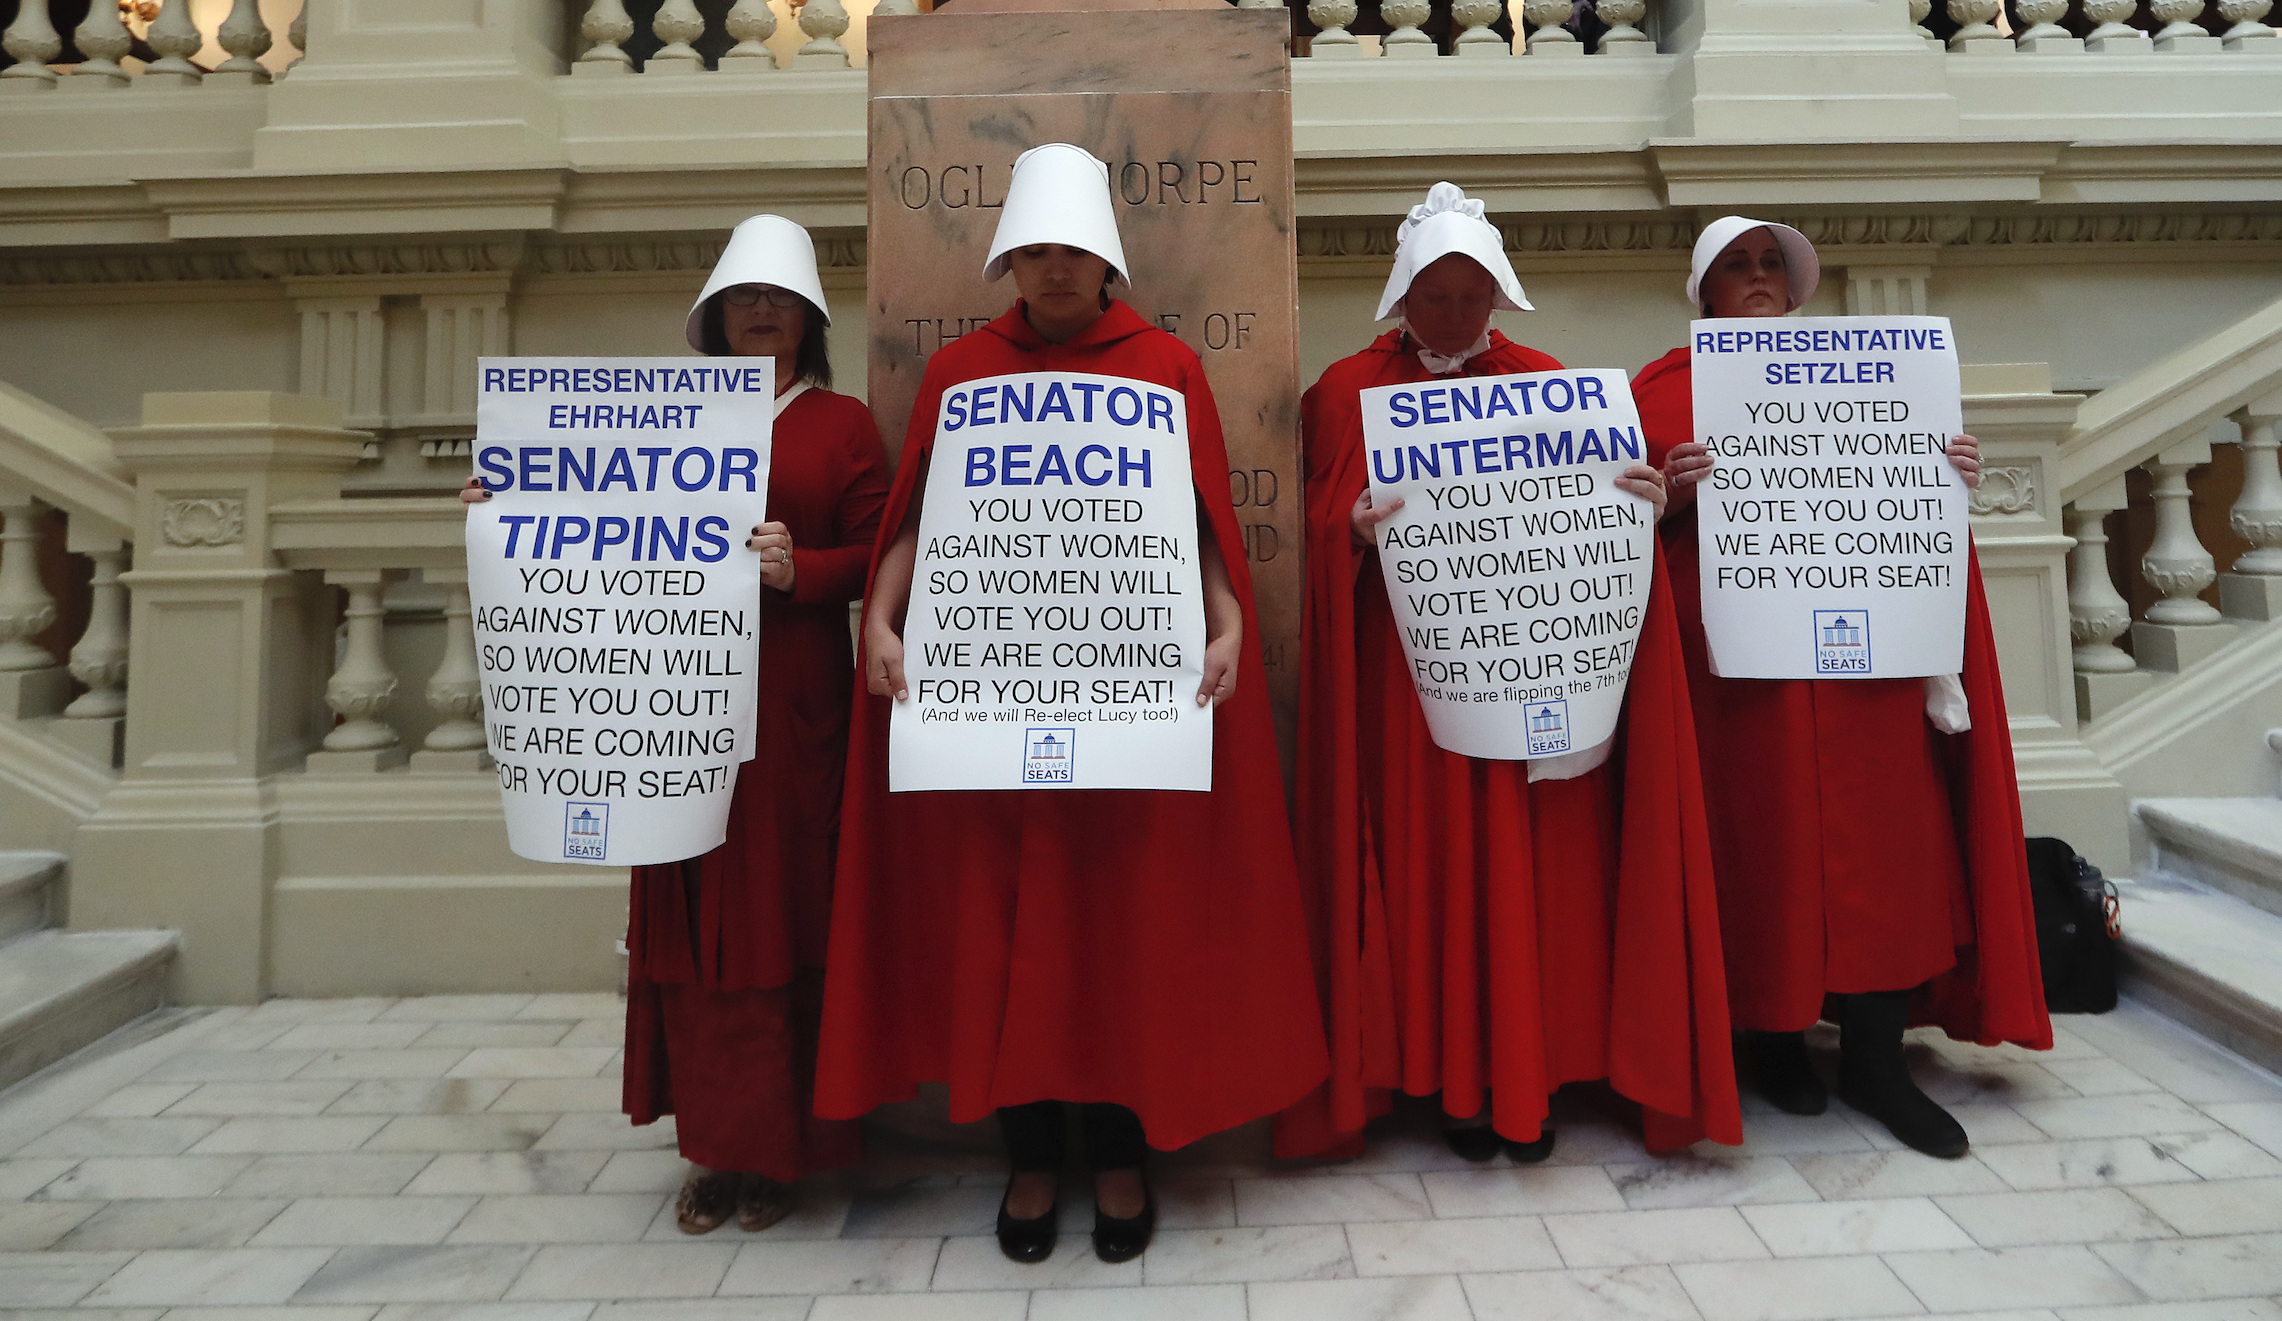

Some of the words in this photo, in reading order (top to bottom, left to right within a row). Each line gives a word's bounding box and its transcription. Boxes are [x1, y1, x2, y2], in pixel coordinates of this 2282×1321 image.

[1204, 312, 1257, 351] OF
[1697, 329, 1945, 353] REPRESENTATIVE
[485, 368, 761, 393] REPRESENTATIVE
[1766, 362, 1894, 384] SETZLER
[944, 382, 1175, 434] SENATOR
[1389, 376, 1607, 428] SENATOR
[1745, 402, 1805, 424] YOU
[1814, 401, 1909, 423] VOTED
[548, 405, 702, 430] EHRHART
[1373, 426, 1640, 484] UNTERMAN
[1704, 434, 1824, 457] AGAINST
[1834, 433, 1947, 455] WOMEN
[479, 447, 758, 492] SENATOR
[964, 444, 1152, 488] BEACH
[1712, 468, 1751, 490] SO
[1760, 467, 1873, 489] WOMEN
[1883, 466, 1950, 488] WILL
[1426, 484, 1490, 511] YOU
[1500, 474, 1594, 503] VOTED
[969, 499, 1032, 522] YOU
[1042, 499, 1143, 522] VOTED
[1722, 500, 1797, 522] VOTE
[1805, 500, 1866, 522] YOU
[1877, 499, 1943, 521] OUT!
[1385, 516, 1513, 550] AGAINST
[1522, 503, 1644, 538] WOMEN,
[498, 516, 731, 563] TIPPINS
[925, 534, 1051, 561] AGAINST
[1060, 534, 1186, 564] WOMEN,
[1715, 533, 1760, 555] WE
[1769, 533, 1825, 555] ARE
[1835, 532, 1952, 555] COMING
[1397, 559, 1437, 584] SO
[1447, 546, 1566, 580] WOMEN
[1573, 538, 1640, 565] WILL
[520, 569, 589, 595] YOU
[601, 571, 705, 596] VOTED
[928, 571, 968, 595] SO
[979, 570, 1100, 594] WOMEN
[1112, 570, 1182, 595] WILL
[1718, 567, 1776, 589] FOR
[1785, 566, 1868, 588] YOUR
[1878, 566, 1950, 588] SEAT!
[1409, 590, 1487, 617] VOTE
[1496, 581, 1559, 610] YOU
[1570, 573, 1634, 601] OUT!
[477, 606, 605, 634] AGAINST
[615, 609, 752, 639] WOMEN,
[935, 606, 1013, 631] VOTE
[1023, 606, 1089, 631] YOU
[1100, 606, 1172, 631] OUT!
[1407, 624, 1450, 651] WE
[1460, 622, 1520, 649] ARE
[1529, 606, 1638, 644] COMING
[483, 647, 516, 673] SO
[525, 647, 651, 675] WOMEN
[663, 649, 742, 676] WILL
[924, 643, 971, 667] WE
[981, 643, 1043, 667] ARE
[1053, 643, 1181, 668] COMING
[1415, 659, 1469, 683] FOR
[1477, 654, 1563, 683] YOUR
[1574, 639, 1635, 674] SEAT!
[1821, 658, 1866, 670] SEATS
[490, 685, 556, 714] VOTE
[568, 687, 638, 716] YOU
[649, 688, 729, 717] OUT!
[919, 680, 980, 704] FOR
[991, 680, 1082, 704] YOUR
[1090, 680, 1174, 704] SEAT!
[1446, 688, 1468, 702] we
[1473, 688, 1498, 703] are
[1503, 682, 1564, 704] flipping
[1567, 678, 1592, 695] the
[1595, 674, 1615, 691] 7th
[921, 708, 961, 724] (And
[965, 709, 988, 722] we
[993, 709, 1018, 722] will
[1025, 709, 1093, 722] Re-elect
[1099, 709, 1137, 726] Lucy
[1142, 708, 1179, 724] too!)
[524, 726, 584, 755] ARE
[594, 728, 735, 758] COMING
[1530, 734, 1544, 742] NO
[1546, 732, 1567, 741] SAFE
[1532, 740, 1567, 752] SEATS
[535, 767, 627, 798] YOUR
[638, 764, 728, 798] SEAT!
[1028, 770, 1068, 780] SEATS
[568, 837, 579, 845] NO
[583, 837, 603, 846] SAFE
[568, 845, 602, 857] SEATS
